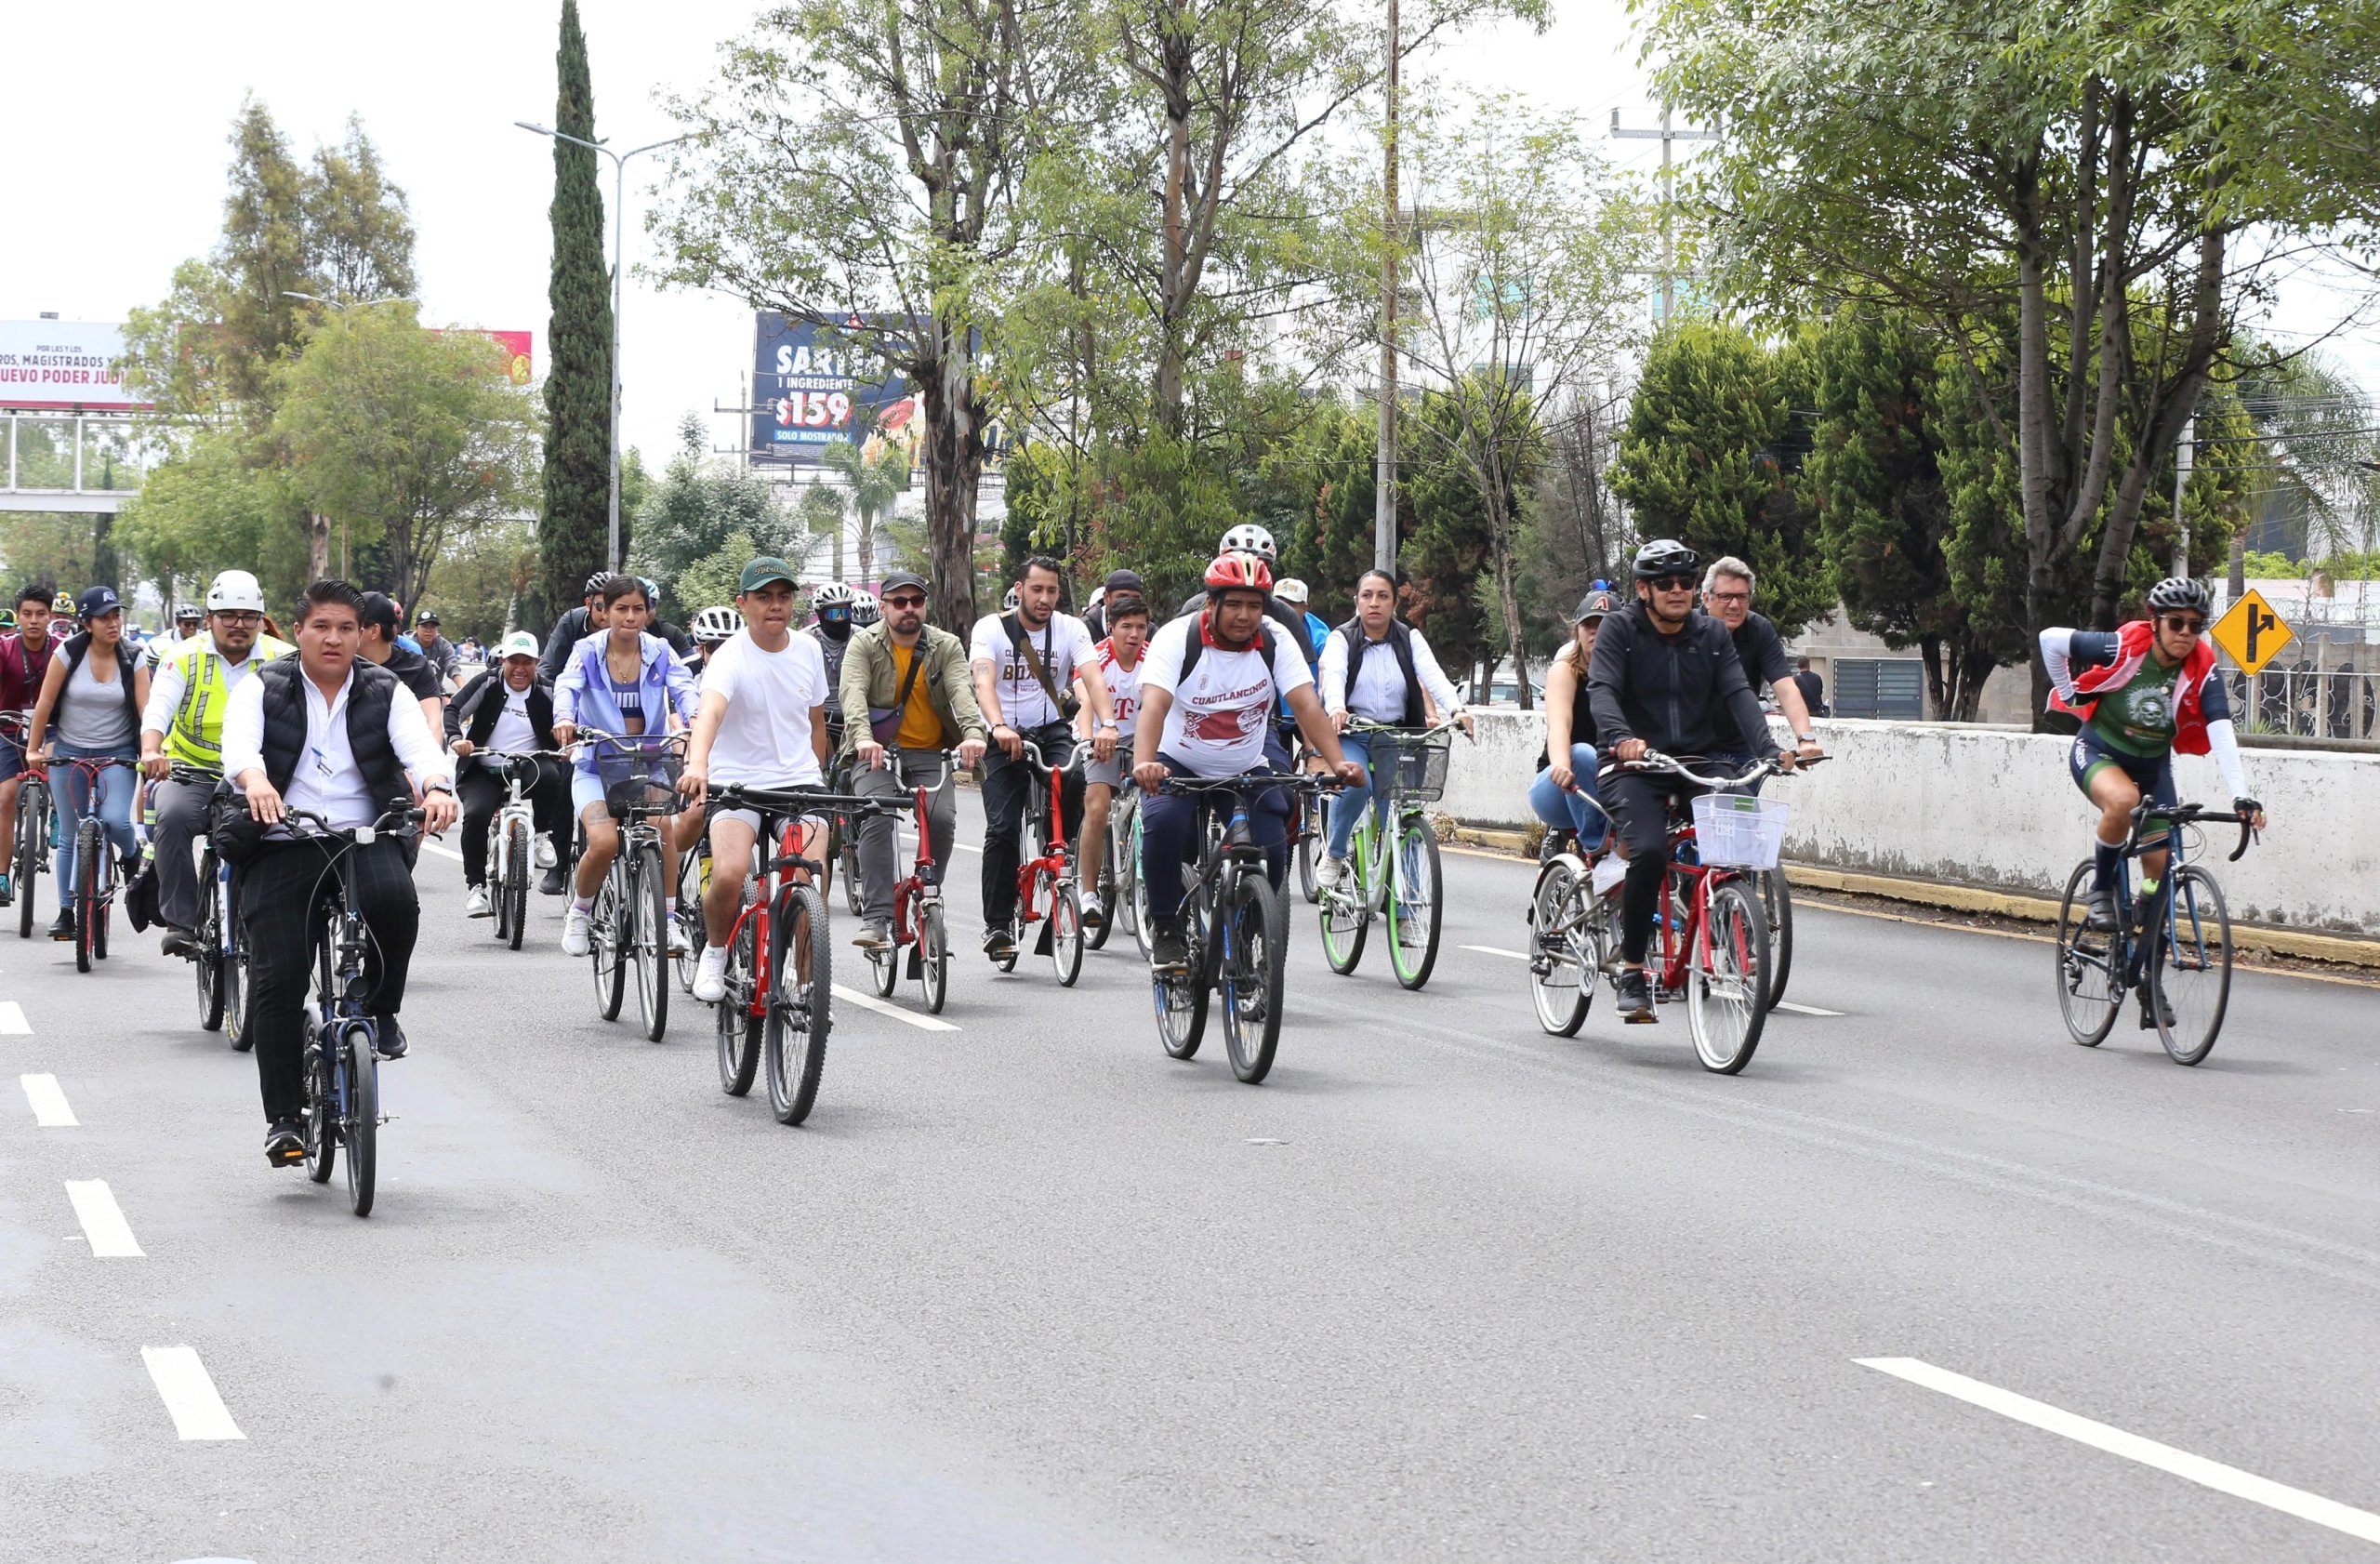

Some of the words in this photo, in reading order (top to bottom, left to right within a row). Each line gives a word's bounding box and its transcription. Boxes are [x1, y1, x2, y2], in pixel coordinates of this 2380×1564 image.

[22, 354, 103, 367] MAGISTRADOS
[0, 369, 38, 382] UEVO
[42, 370, 90, 383] PODER
[777, 377, 783, 388] 1
[775, 391, 852, 427] $159
[777, 431, 798, 441] SOLO
